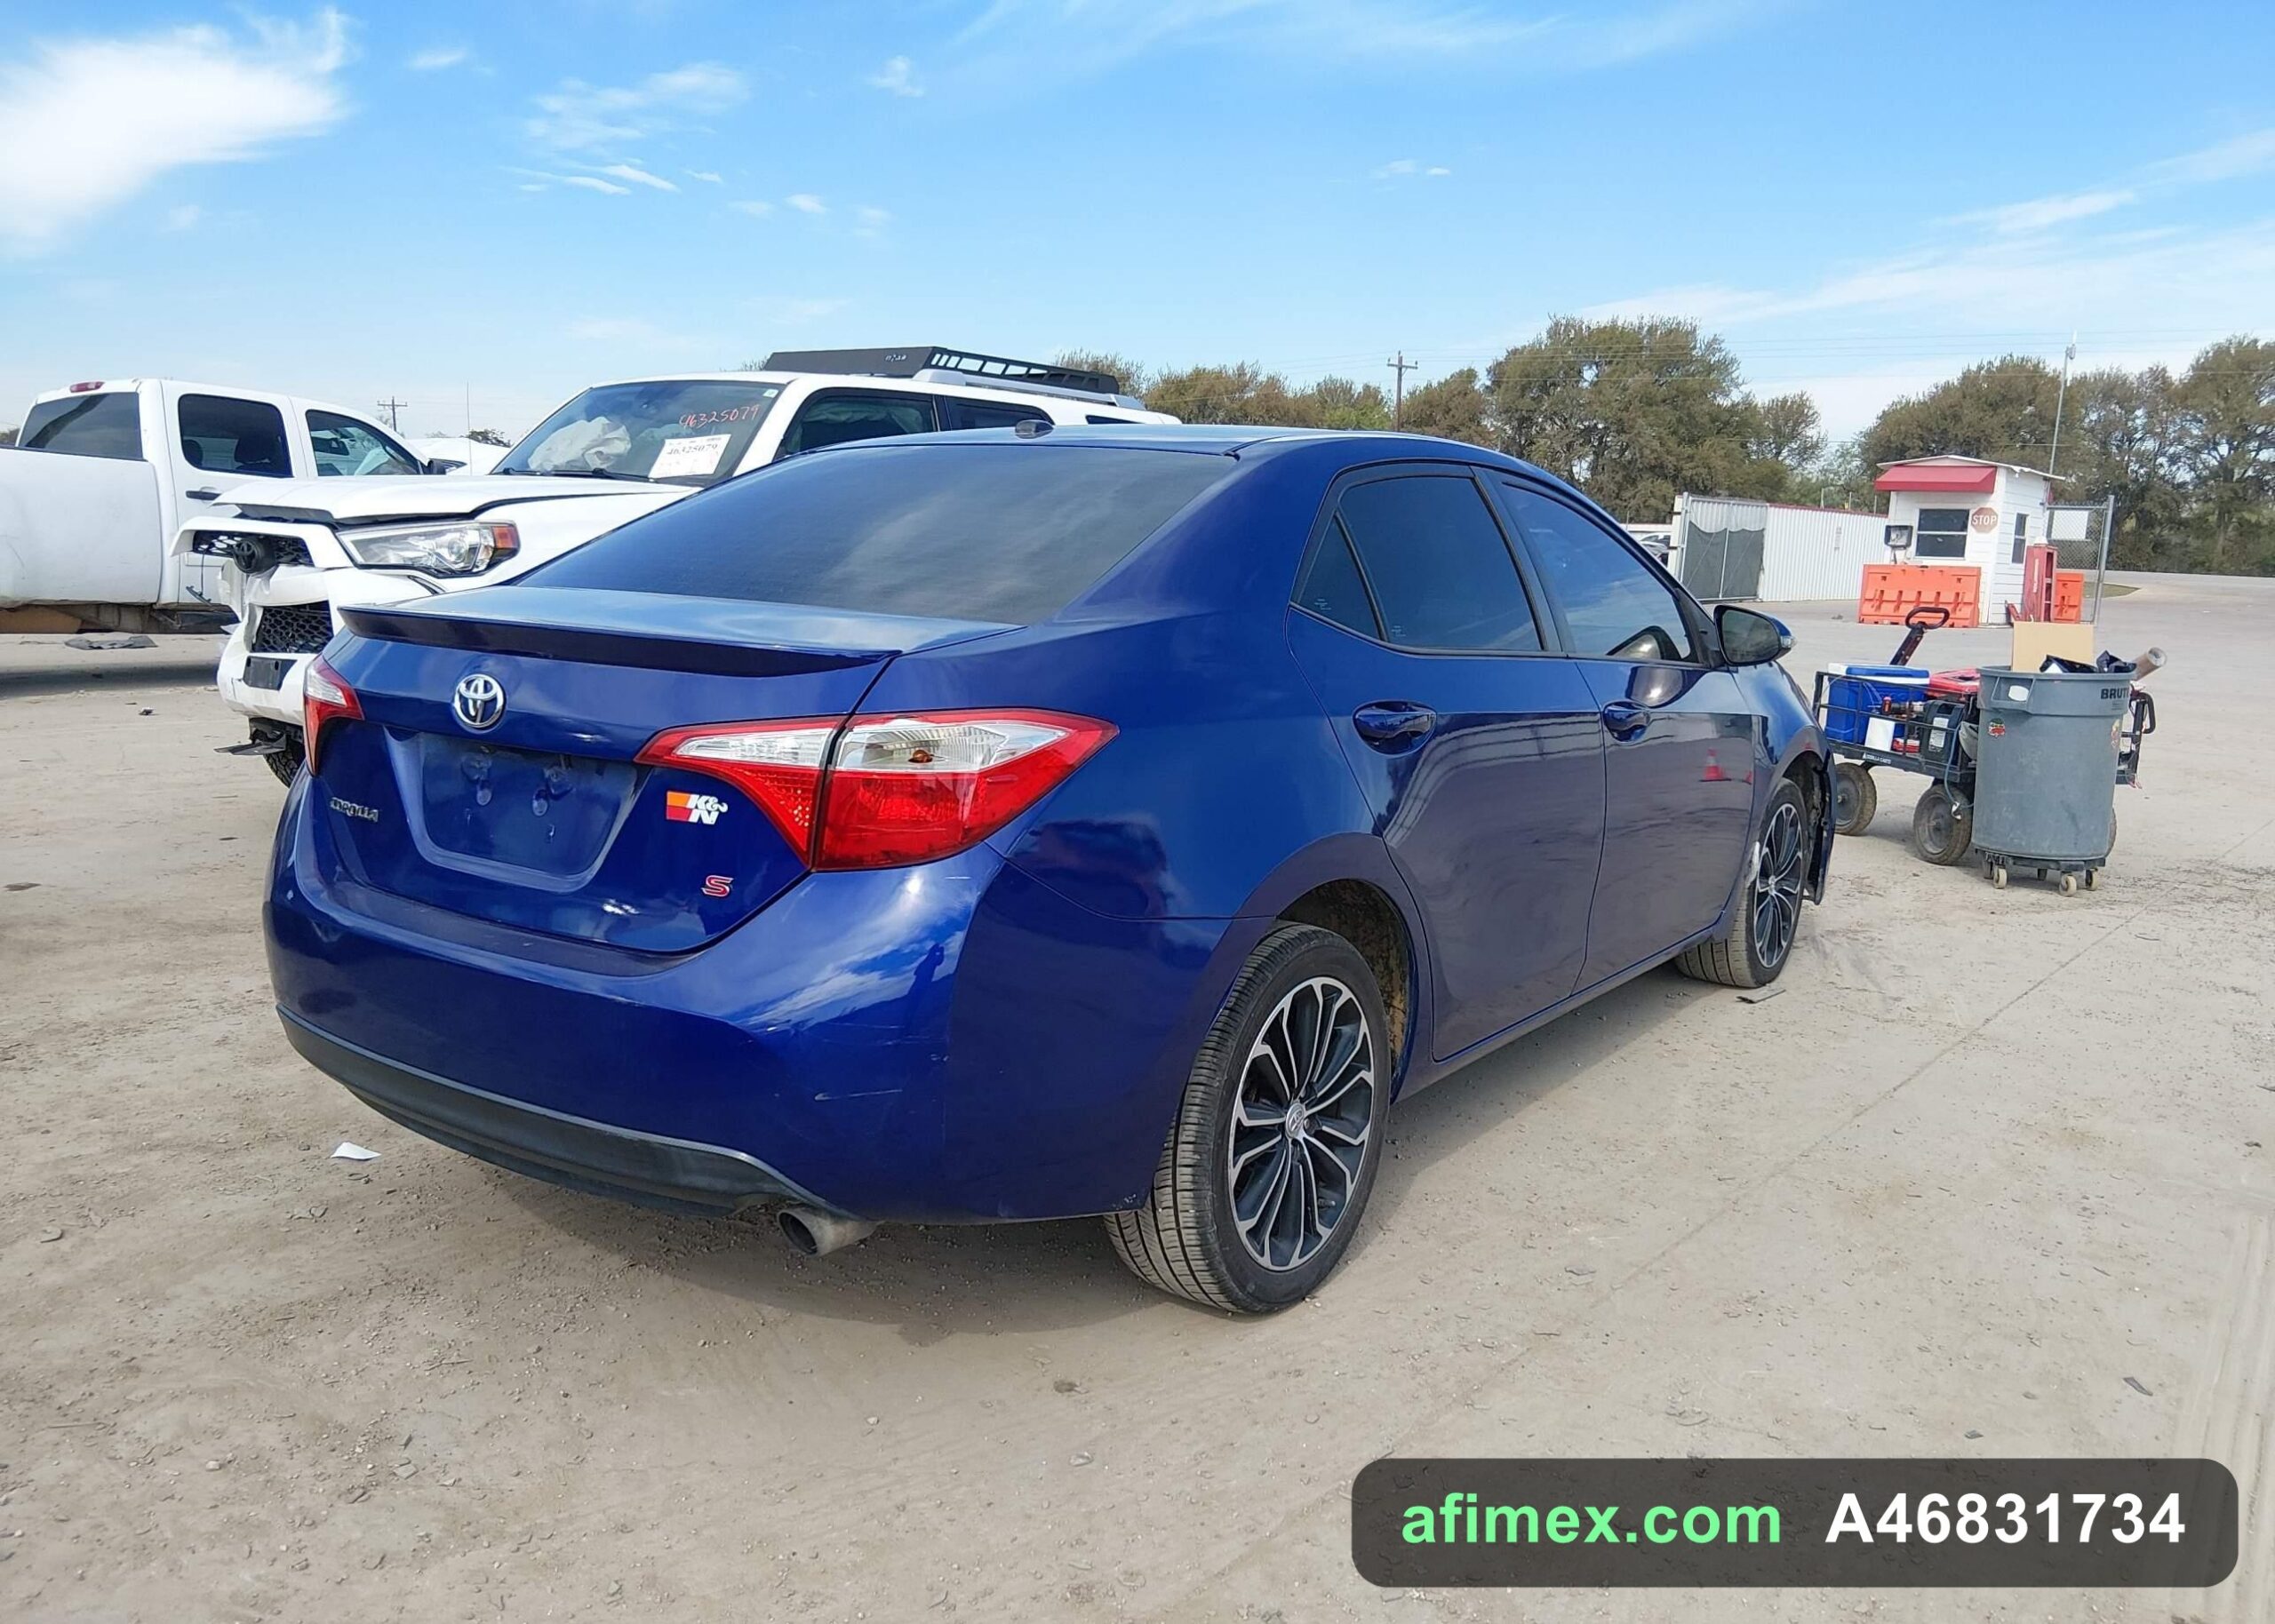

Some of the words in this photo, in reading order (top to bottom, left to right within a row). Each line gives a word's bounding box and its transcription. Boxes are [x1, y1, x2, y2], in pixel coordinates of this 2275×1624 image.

[679, 404, 761, 430] 46325079
[1972, 515, 1997, 526] STOP
[330, 797, 379, 823] COROLLA
[700, 874, 734, 897] S
